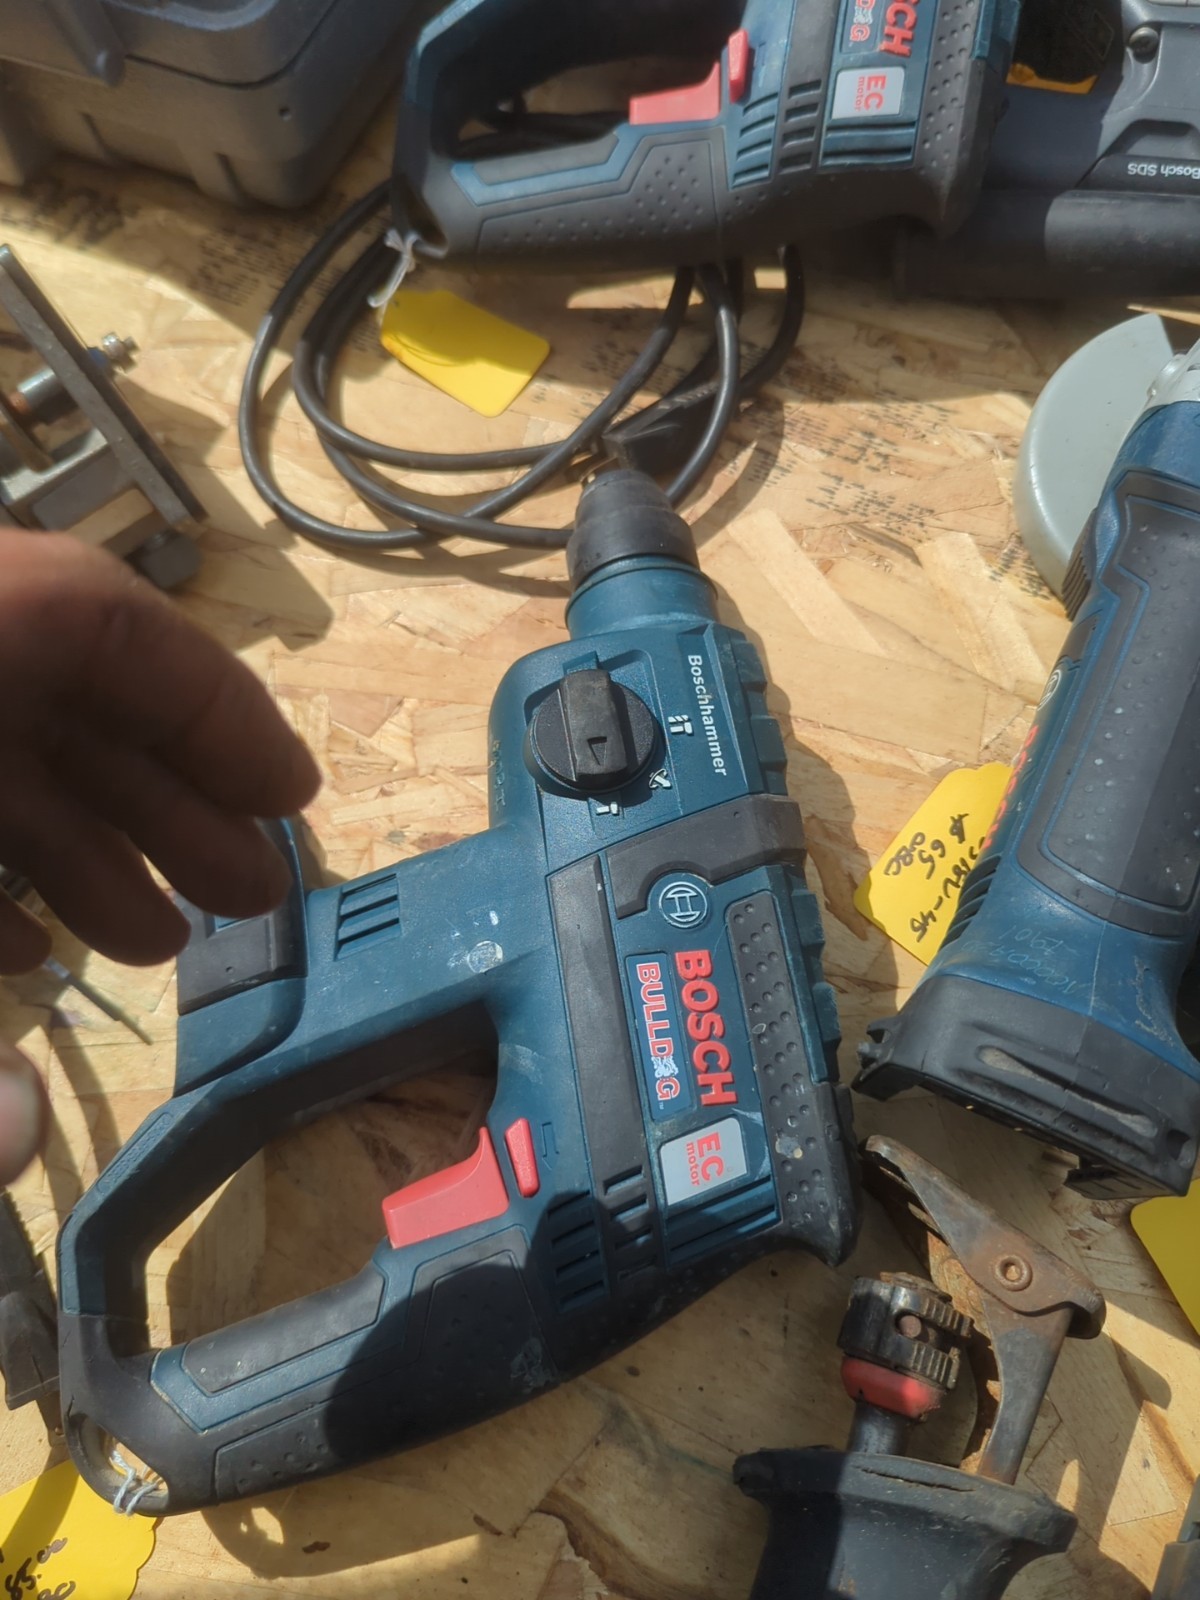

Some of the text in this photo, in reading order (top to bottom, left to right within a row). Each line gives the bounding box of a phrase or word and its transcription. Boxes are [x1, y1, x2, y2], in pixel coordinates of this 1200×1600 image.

[882, 0, 918, 57] CH
[855, 76, 866, 111] motor
[863, 75, 886, 110] EC
[1127, 162, 1200, 179] Bosch SDS
[688, 654, 727, 776] Boschhammer
[636, 961, 682, 1101] BULLDG
[675, 949, 739, 1107] BOSCH
[686, 1142, 701, 1187] motor
[697, 1131, 725, 1183] EC
